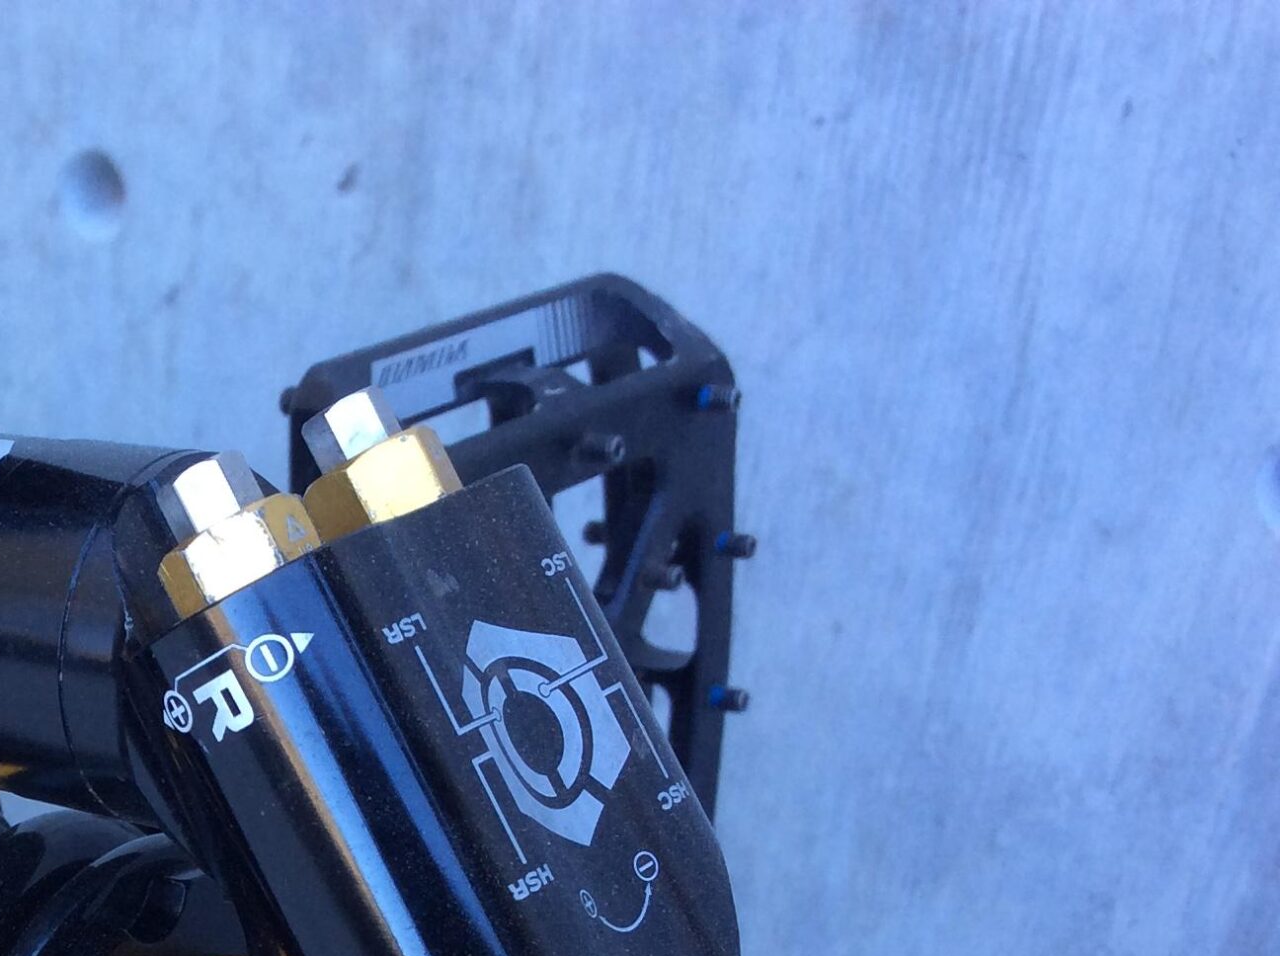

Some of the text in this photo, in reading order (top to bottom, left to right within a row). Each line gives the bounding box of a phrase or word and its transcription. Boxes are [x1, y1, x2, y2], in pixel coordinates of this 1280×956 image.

[541, 553, 572, 576] LSC
[382, 613, 428, 644] LSR
[194, 669, 254, 742] R
[658, 779, 689, 811] HSC
[507, 863, 556, 901] HSR
